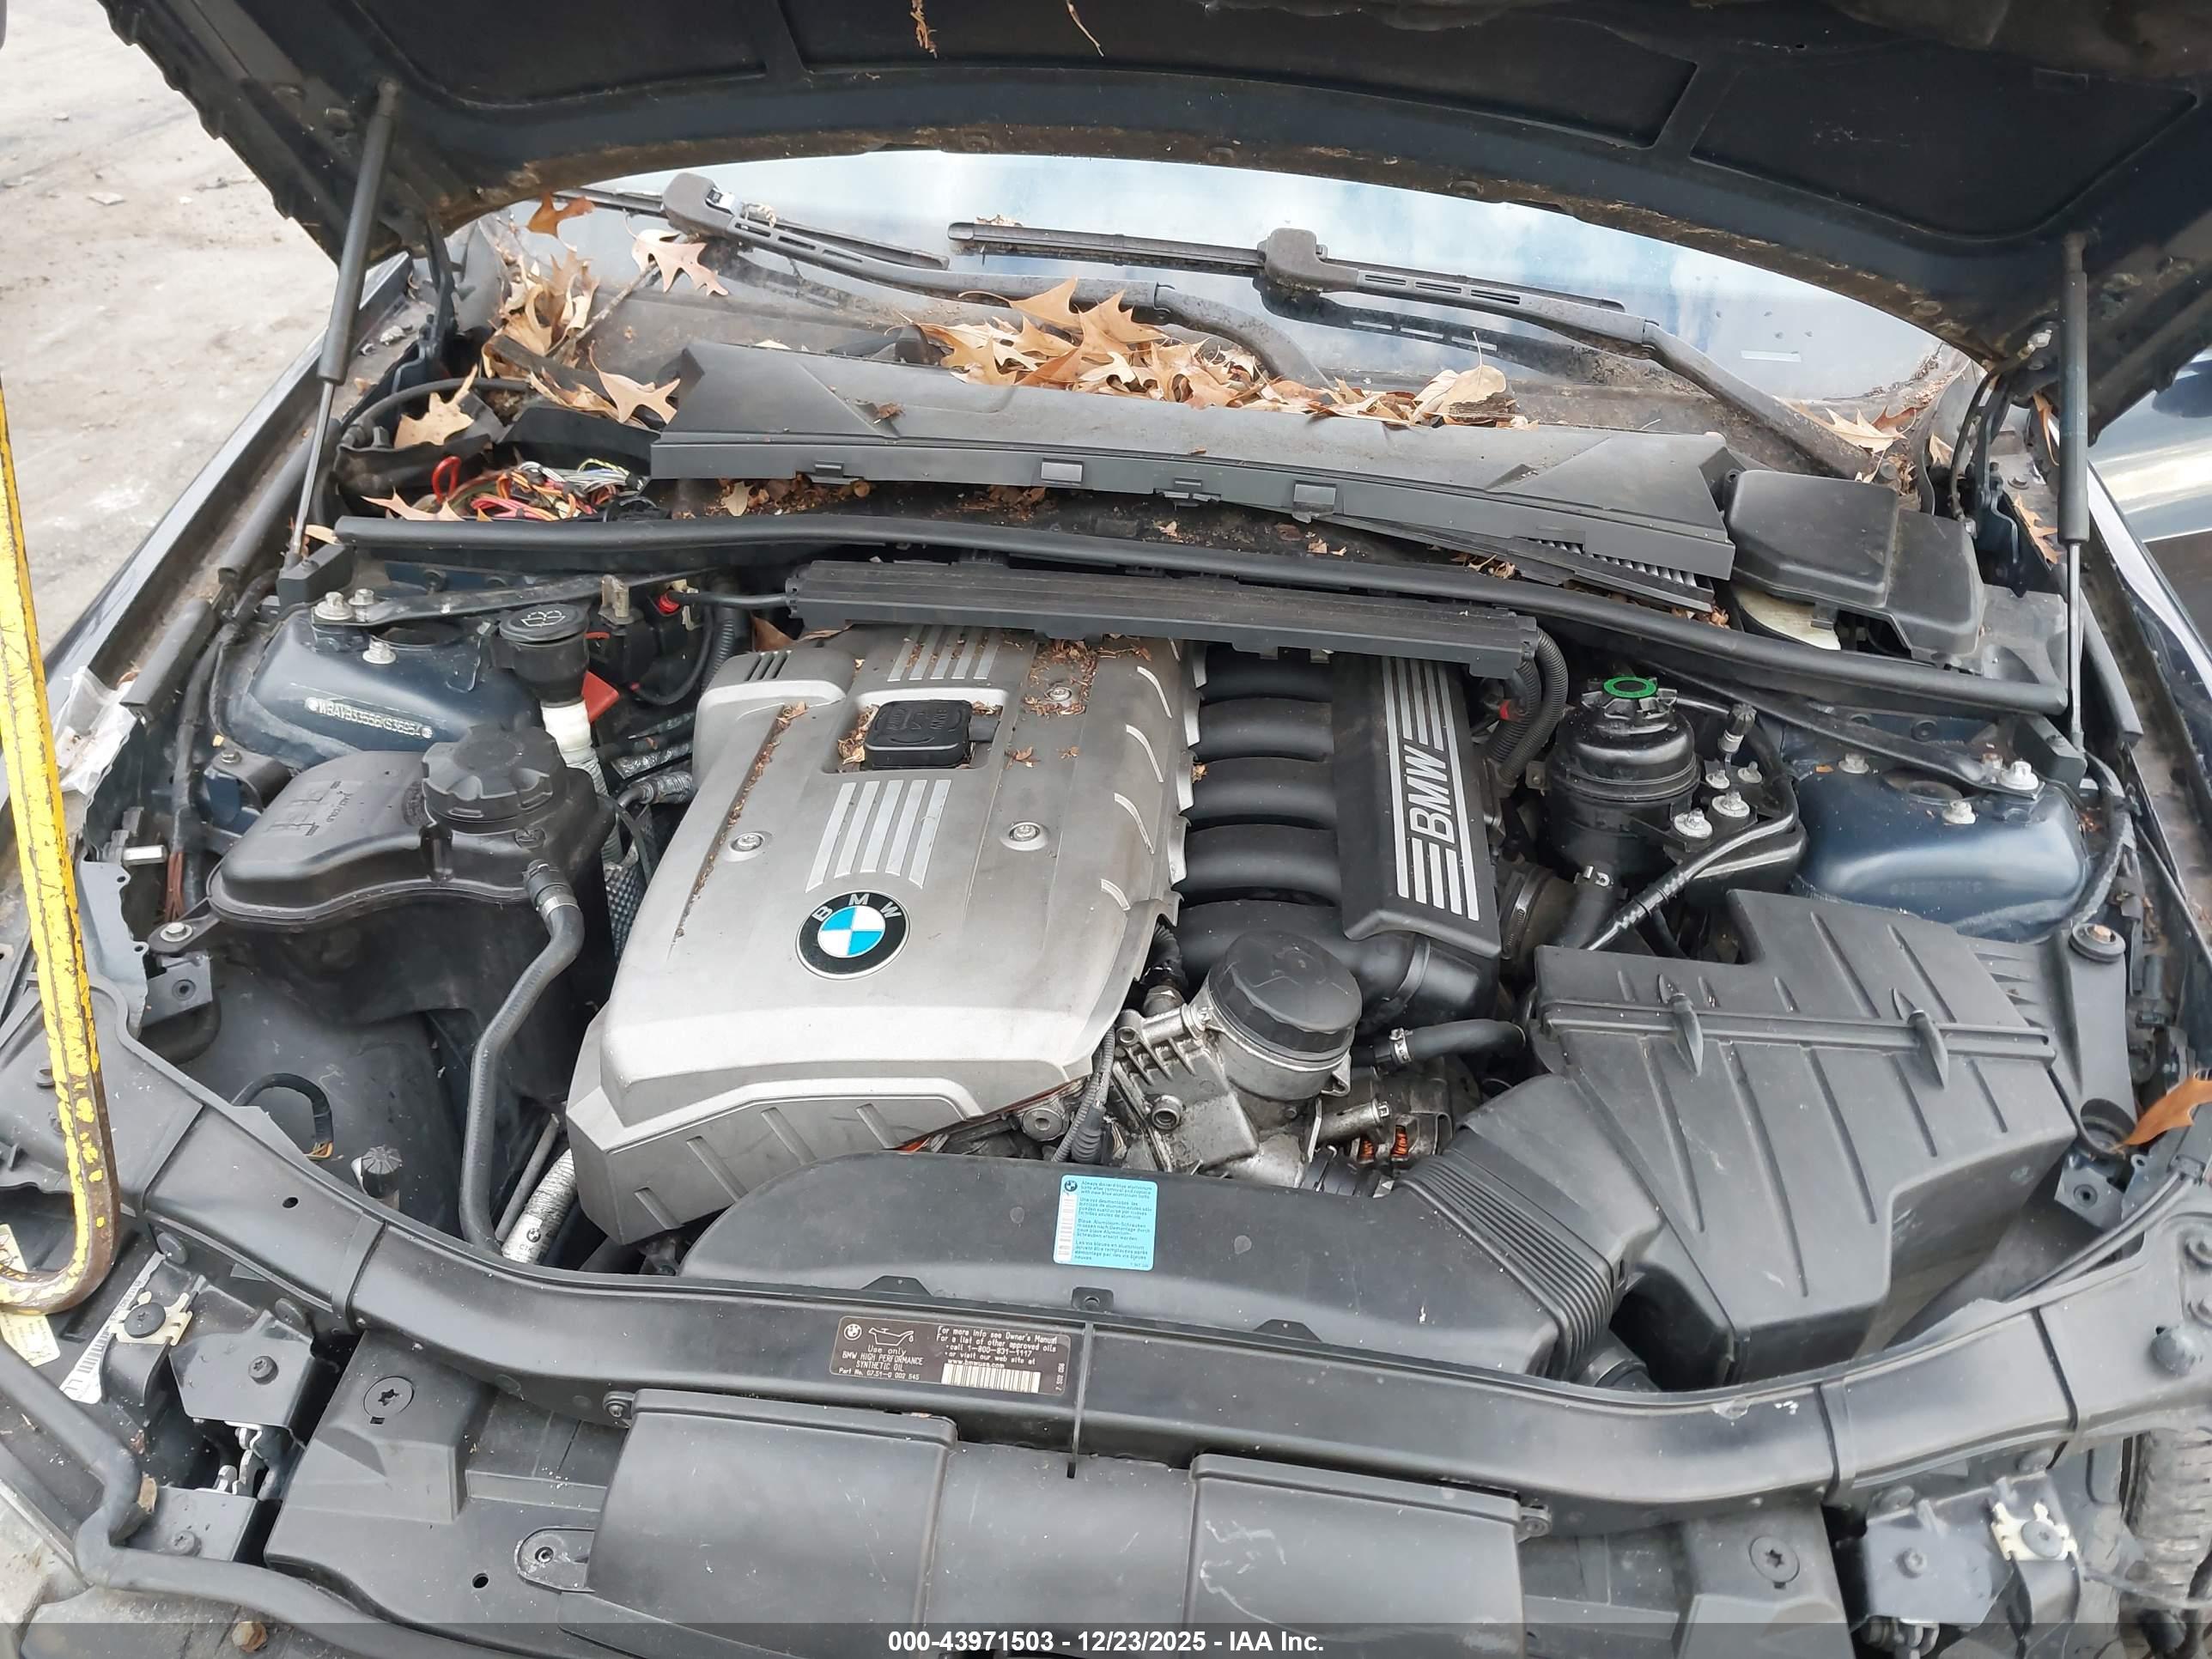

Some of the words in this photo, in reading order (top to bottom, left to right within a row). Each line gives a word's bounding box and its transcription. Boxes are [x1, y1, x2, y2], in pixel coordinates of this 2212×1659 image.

[1404, 744, 1455, 844] BMW
[811, 893, 902, 922] BMW
[938, 1326, 950, 1334] For
[973, 1329, 987, 1338] info
[1006, 1332, 1030, 1341] Owner's
[937, 1334, 948, 1342] For
[1009, 1341, 1039, 1351] approved
[842, 1351, 858, 1359] BMW
[860, 1352, 876, 1361] HIGH
[878, 1354, 924, 1365] PERFORMANCE
[867, 1345, 883, 1353] Use
[888, 1347, 907, 1357] only
[968, 1345, 1032, 1358] 1-800-831-1117
[855, 1360, 890, 1370] SYNTHETIC
